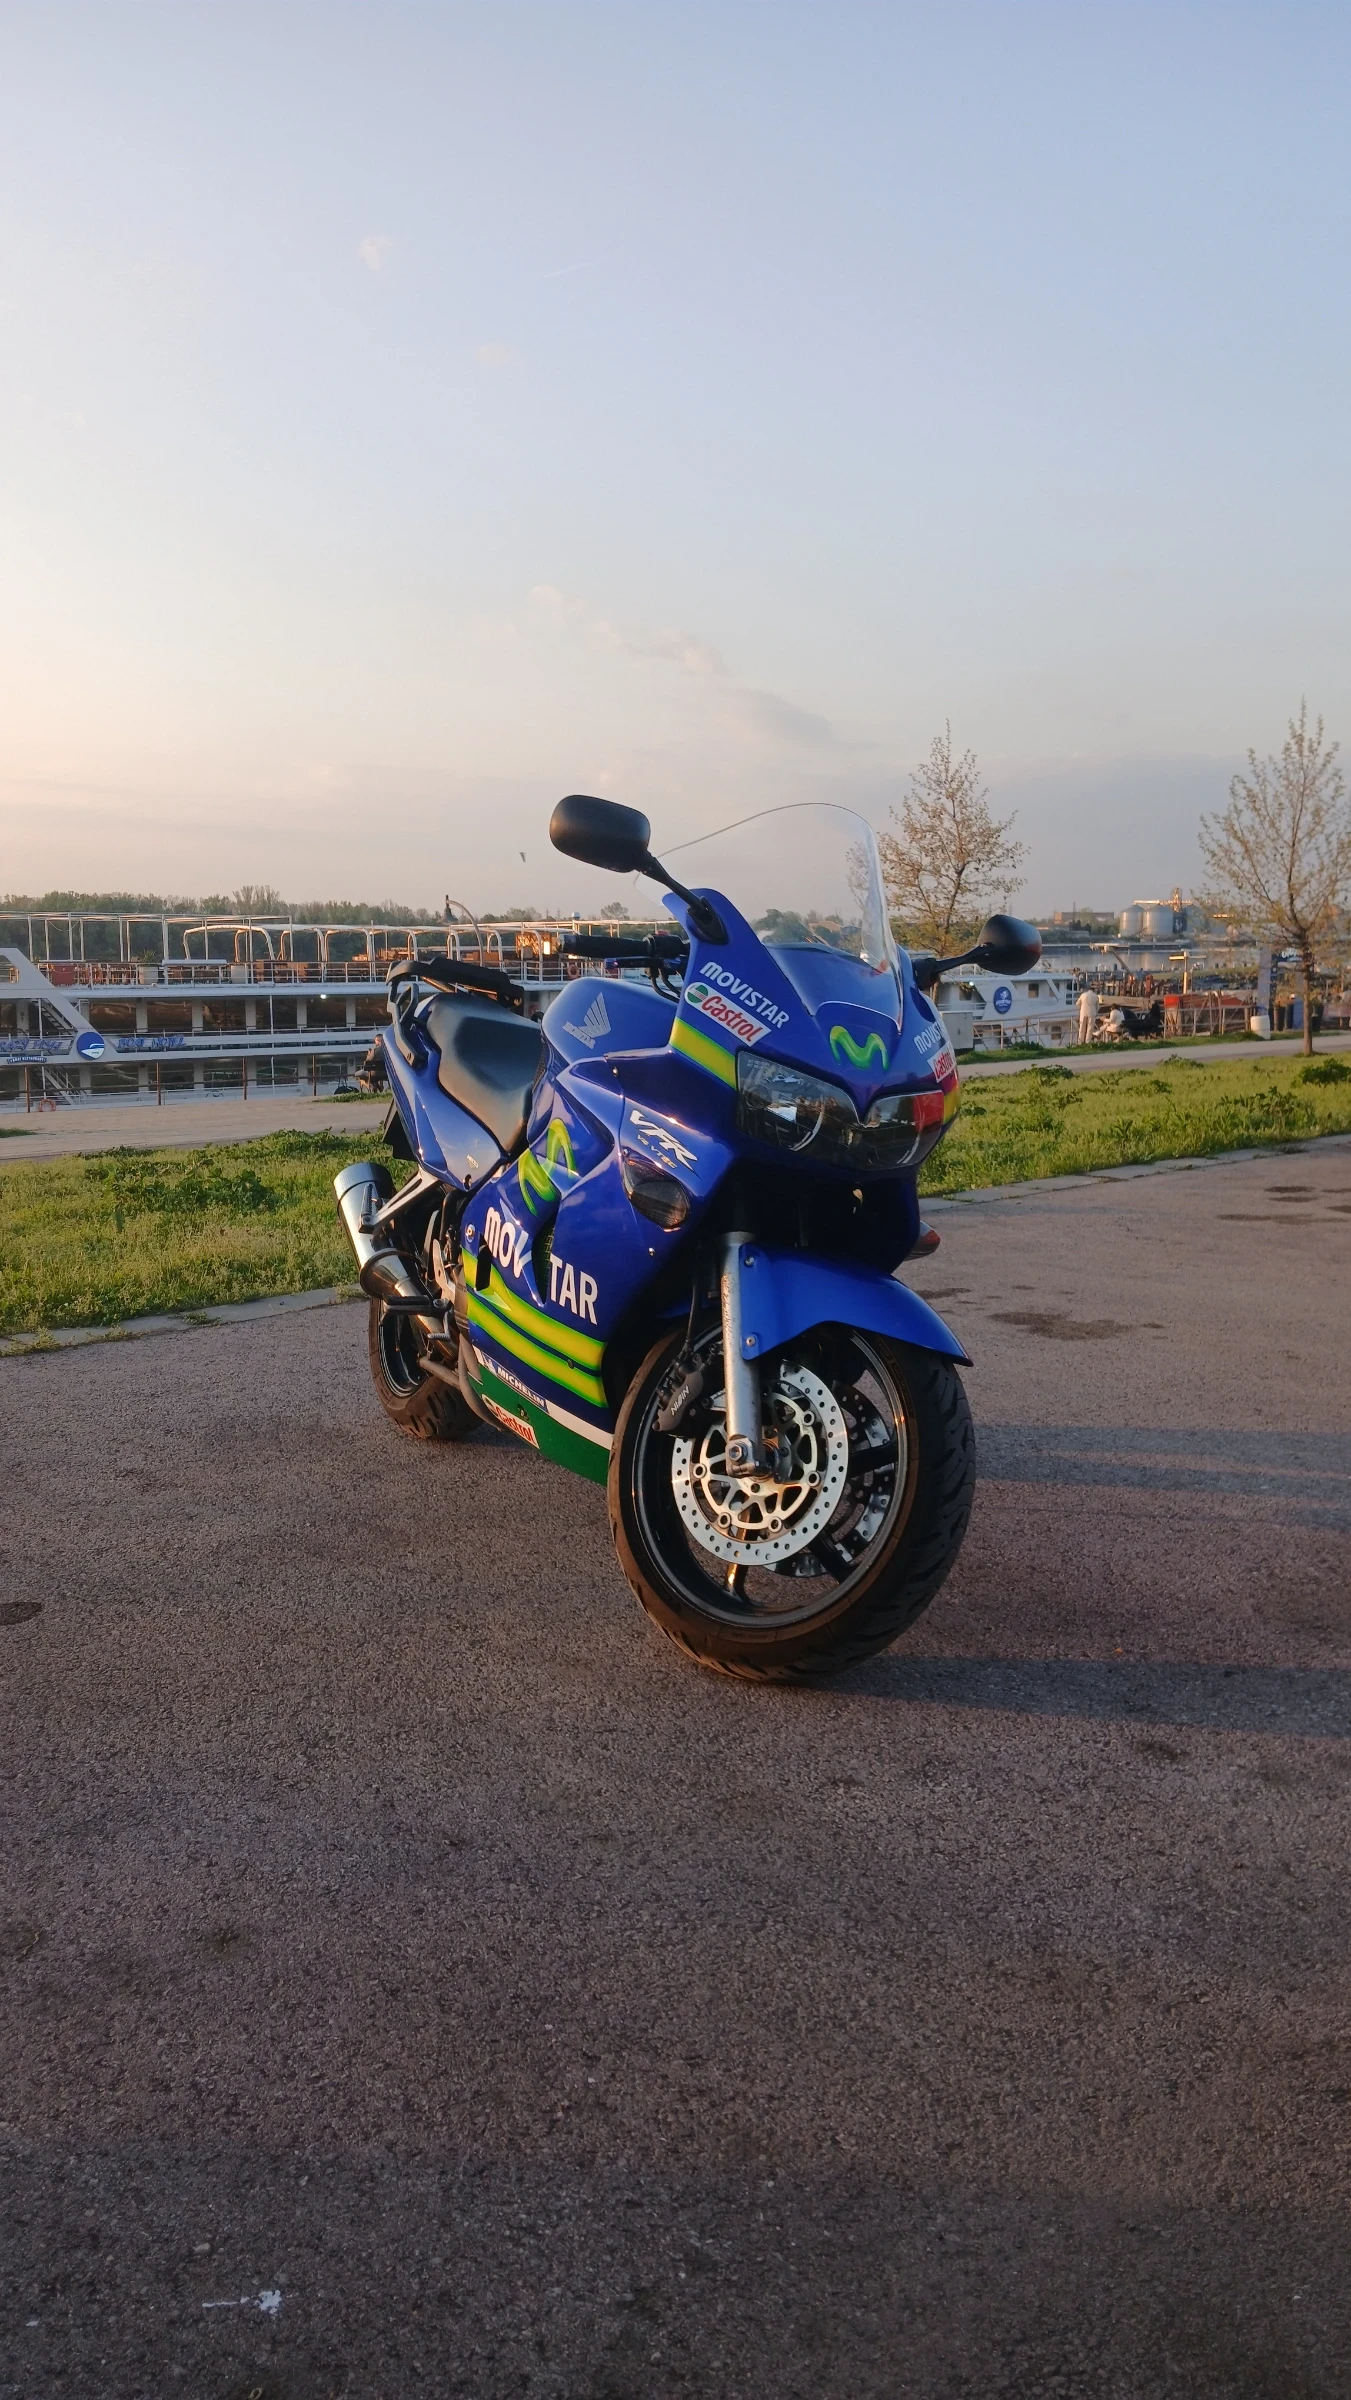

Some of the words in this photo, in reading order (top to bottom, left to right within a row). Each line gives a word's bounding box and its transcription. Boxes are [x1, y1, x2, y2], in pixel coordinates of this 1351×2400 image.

[699, 961, 790, 1029] MOVISTAR
[701, 995, 763, 1042] Castrol
[497, 1366, 546, 1408] MICHELIN
[494, 1406, 538, 1445] Castrol
